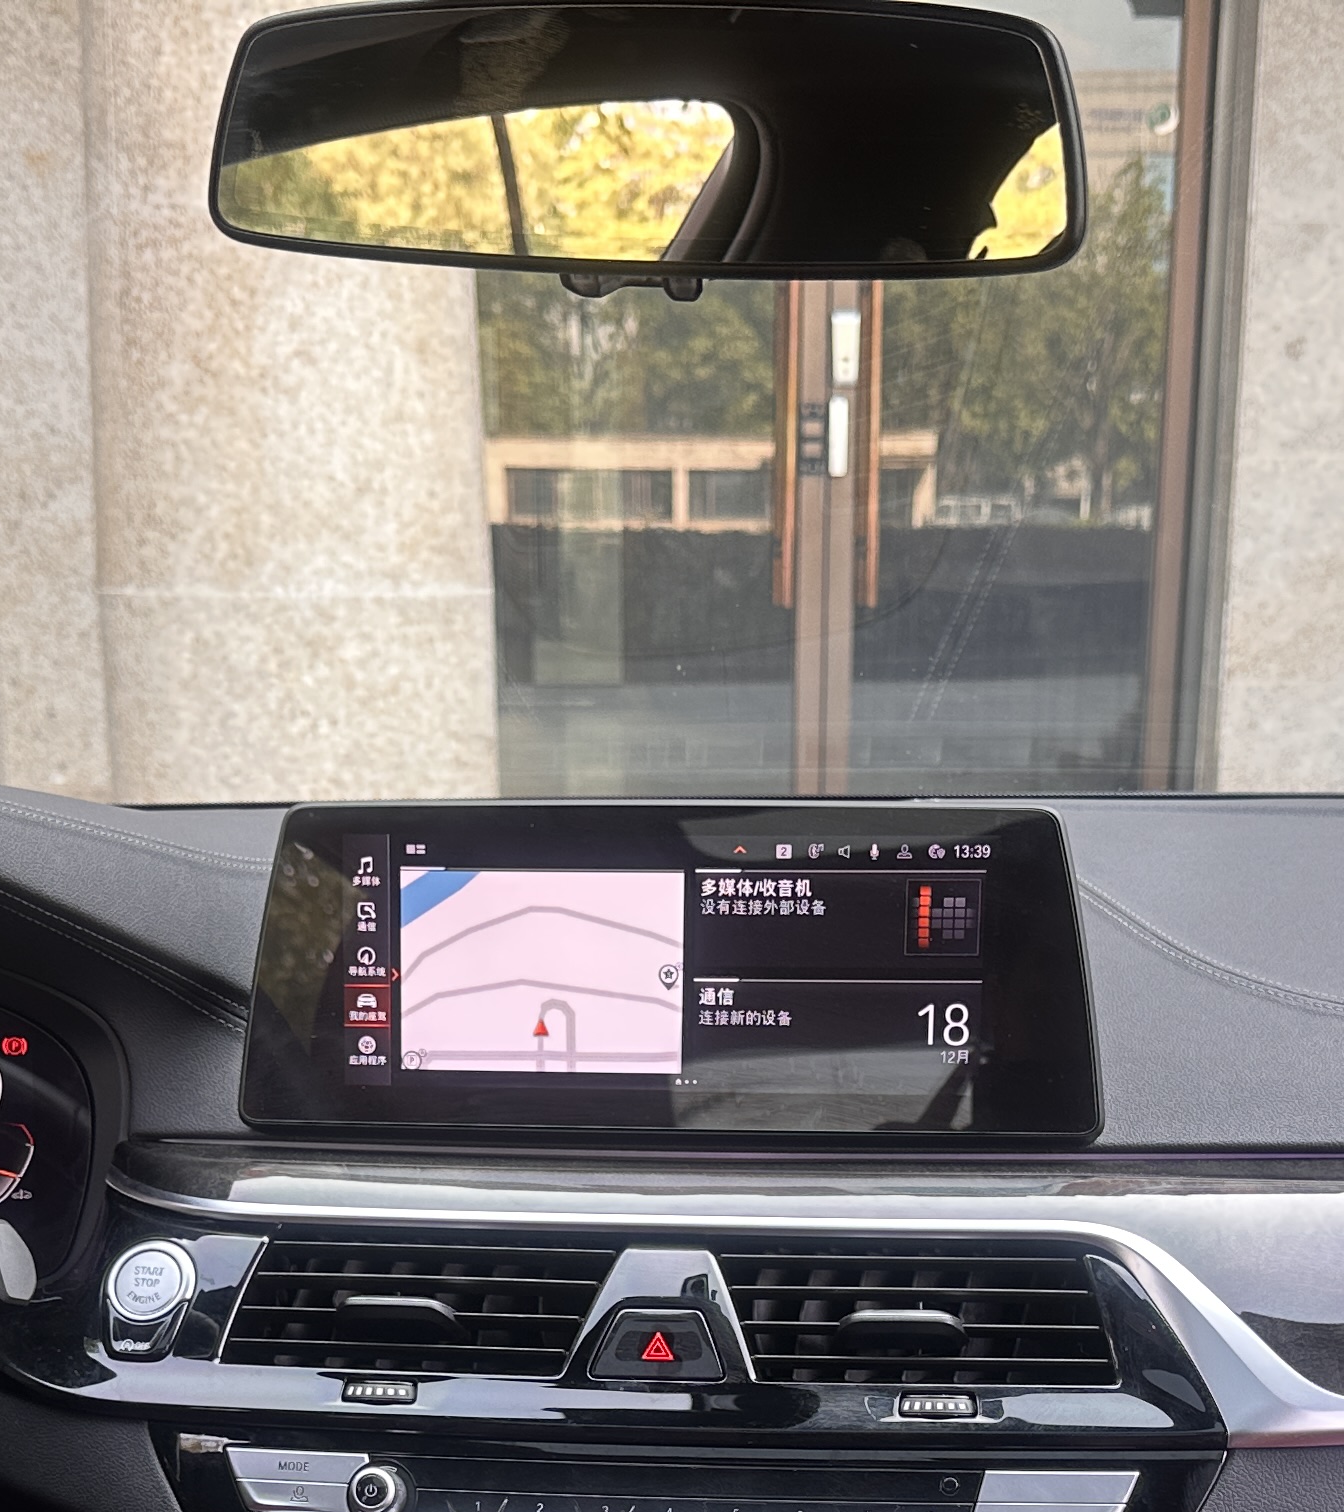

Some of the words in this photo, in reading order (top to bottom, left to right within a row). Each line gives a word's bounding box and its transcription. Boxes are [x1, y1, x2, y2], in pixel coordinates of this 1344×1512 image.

[953, 844, 991, 859] 13:39
[352, 875, 381, 887] 多媒体
[700, 878, 812, 898] 多媒体/收音机
[700, 899, 827, 916] 没有连接外部设备
[348, 965, 387, 978] 导航系统
[698, 987, 735, 1006] 通信
[698, 1010, 793, 1027] 连接新的设备
[917, 1002, 971, 1047] 18
[939, 1050, 970, 1065] 12月
[134, 1265, 165, 1277] START
[134, 1277, 161, 1288] STOP
[126, 1290, 162, 1304] ENGINE
[277, 1460, 310, 1472] MODE
[474, 1501, 481, 1512] 1
